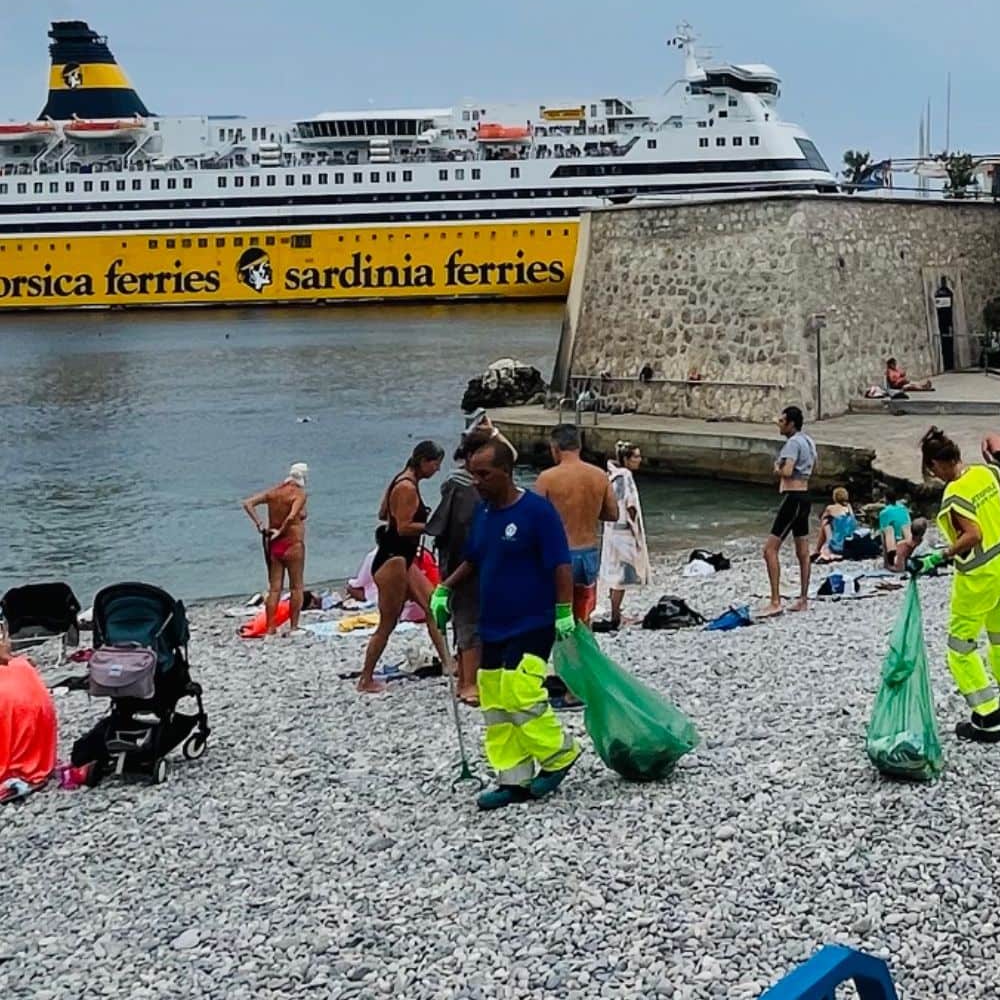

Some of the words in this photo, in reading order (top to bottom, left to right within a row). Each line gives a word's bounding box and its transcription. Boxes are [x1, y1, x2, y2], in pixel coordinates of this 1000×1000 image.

[105, 259, 221, 297] ferries
[284, 252, 435, 290] sardinia
[444, 249, 566, 286] ferries
